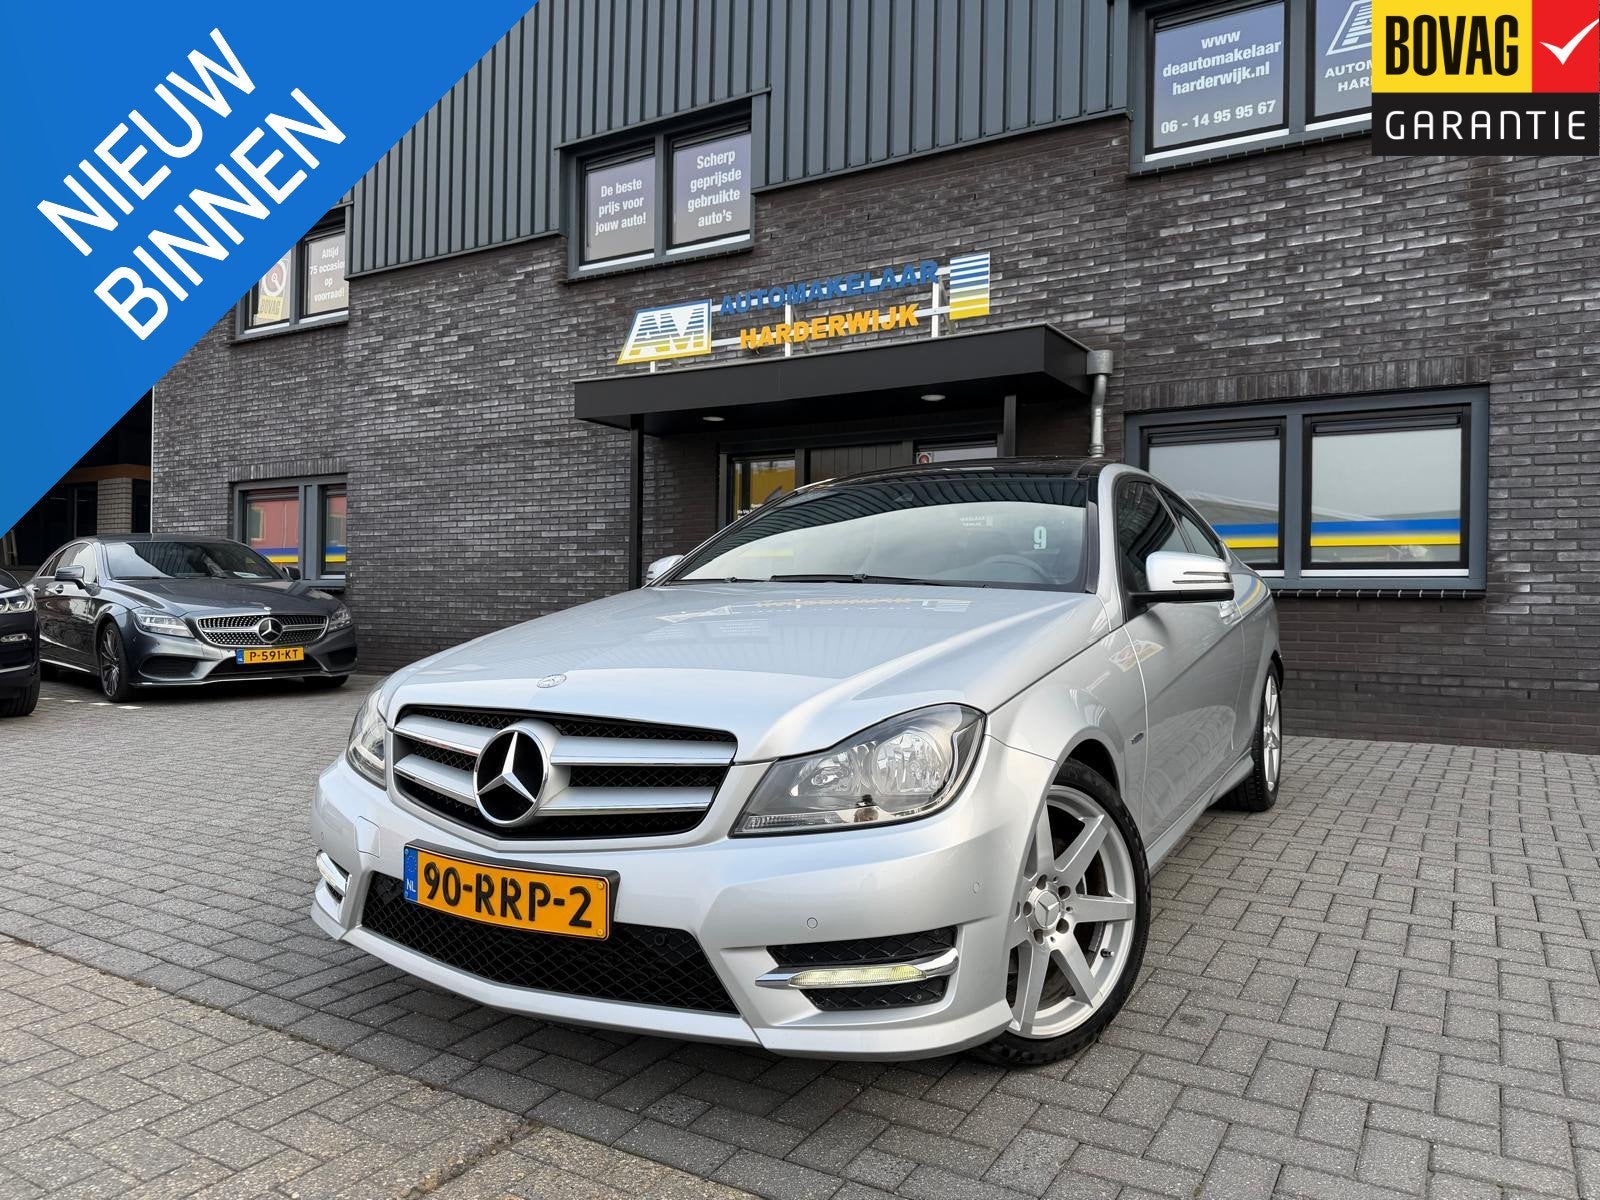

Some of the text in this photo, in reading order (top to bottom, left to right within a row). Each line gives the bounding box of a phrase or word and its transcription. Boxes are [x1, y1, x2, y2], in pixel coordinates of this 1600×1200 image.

[1201, 30, 1241, 49] www
[1162, 41, 1282, 78] deautomakelaar
[1173, 62, 1270, 96] harderwijk.nl
[1338, 76, 1372, 92] HAR
[1161, 119, 1178, 134] 06
[1192, 114, 1209, 128] 14
[1213, 109, 1231, 124] 95
[1235, 104, 1253, 120] 95
[1258, 100, 1276, 116] 67
[697, 150, 736, 169] Scherp
[601, 178, 642, 197] De beste
[690, 169, 742, 192] geprijsde
[599, 197, 645, 218] prijs voor
[688, 188, 741, 212] gebruikte
[595, 212, 647, 236] jouw auto!
[698, 209, 733, 227] auto's
[322, 246, 339, 259] Altijd
[324, 279, 333, 288] op
[719, 261, 938, 316] AUTOMAKELAAR
[314, 288, 345, 302] voorraad!
[740, 304, 919, 348] HARDERWIJK
[249, 649, 299, 661] P-591-KT
[406, 878, 416, 893] NL
[424, 861, 592, 928] 90-RRP-2
